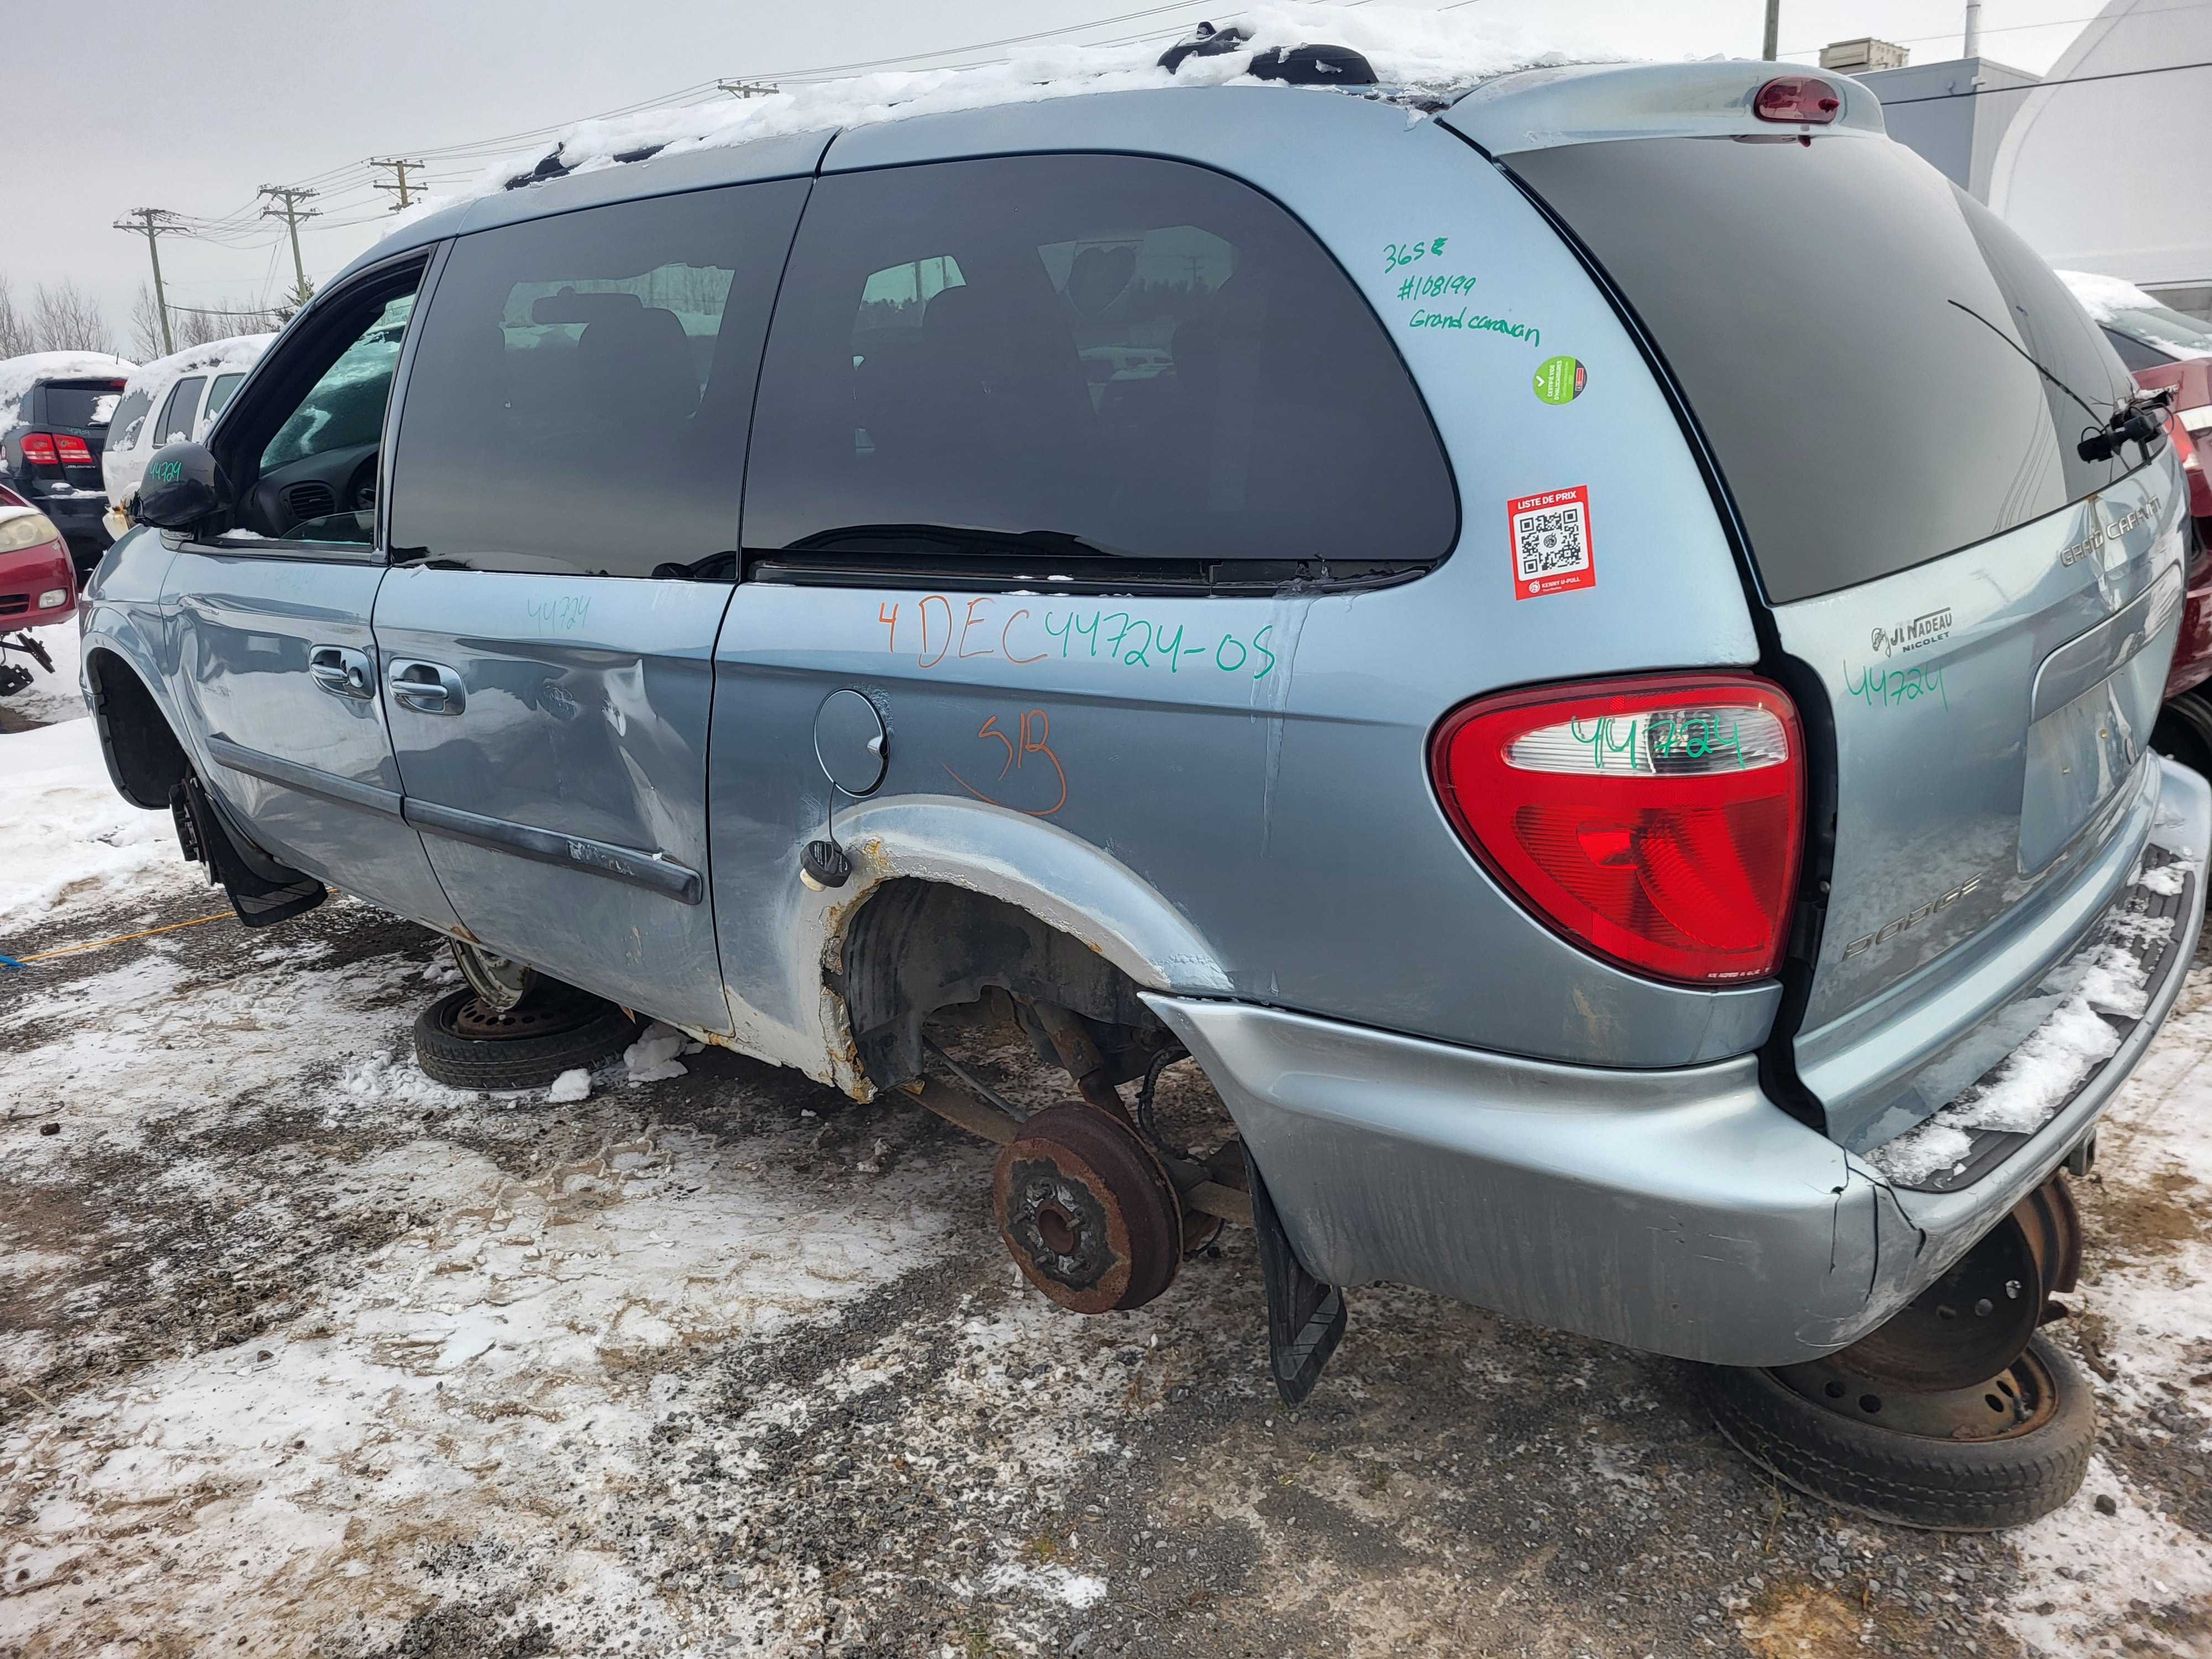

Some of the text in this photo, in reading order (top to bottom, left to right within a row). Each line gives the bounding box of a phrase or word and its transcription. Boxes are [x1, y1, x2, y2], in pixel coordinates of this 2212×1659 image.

[1410, 306, 1467, 329] Grand
[1517, 491, 1577, 510] LISTE DE PRIX
[527, 595, 592, 633] 44724
[879, 594, 1048, 669] 4 DEC
[1907, 607, 1952, 640] NADEAU
[1902, 631, 1950, 653] NICOLET
[1843, 659, 1948, 713] 44724
[1571, 715, 1746, 769] 44724
[1841, 872, 1983, 962] DODGE
